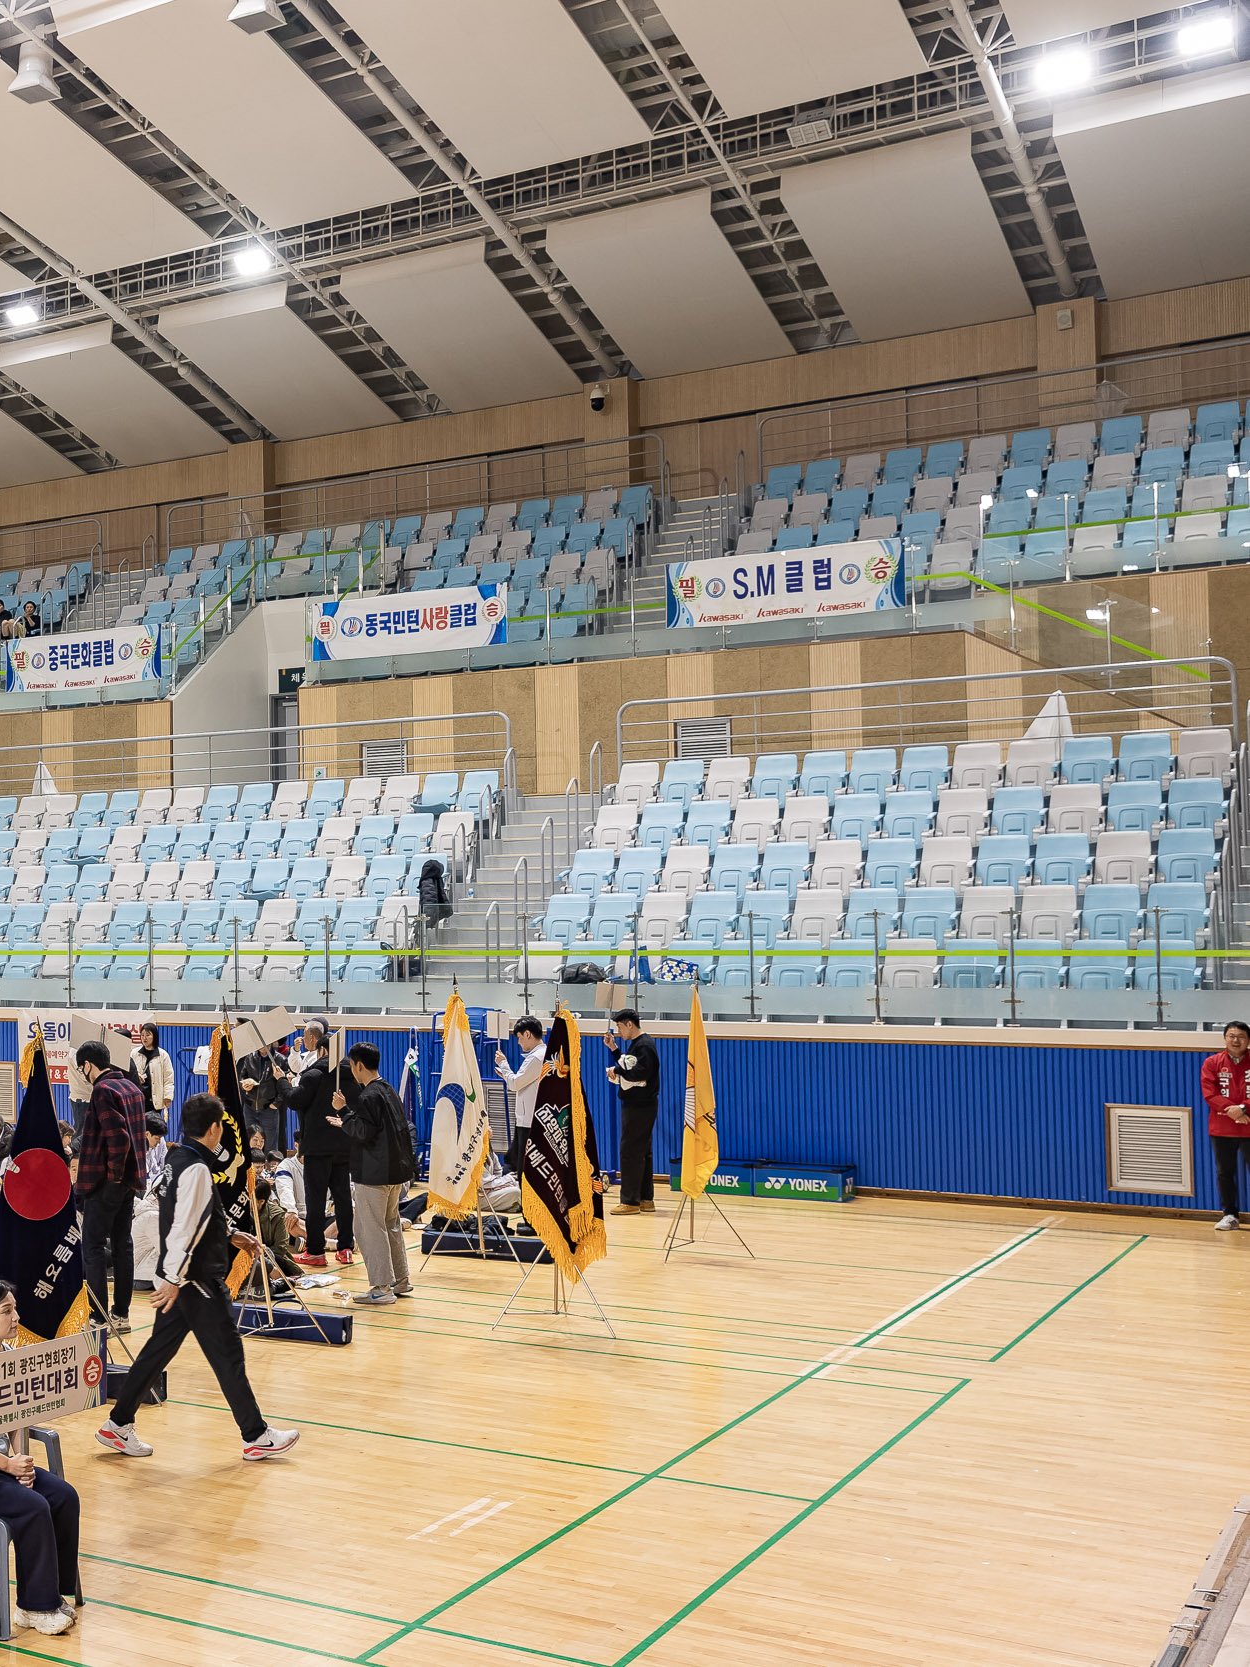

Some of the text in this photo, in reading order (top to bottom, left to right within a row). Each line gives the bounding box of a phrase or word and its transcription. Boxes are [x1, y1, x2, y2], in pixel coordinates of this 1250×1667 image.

[679, 558, 891, 599] 필 S.M 클럽 승
[365, 602, 477, 638] 동국민턴사랑클럽
[486, 602, 498, 617] 승
[14, 636, 152, 672] 필 중곡문화클럽 승
[707, 1175, 740, 1188] ONEX
[788, 1178, 828, 1192] YONEX
[19, 1345, 76, 1376] 광진구협회장기
[87, 1360, 100, 1382] 승
[20, 1398, 66, 1419] 광진구배드민턴협회
